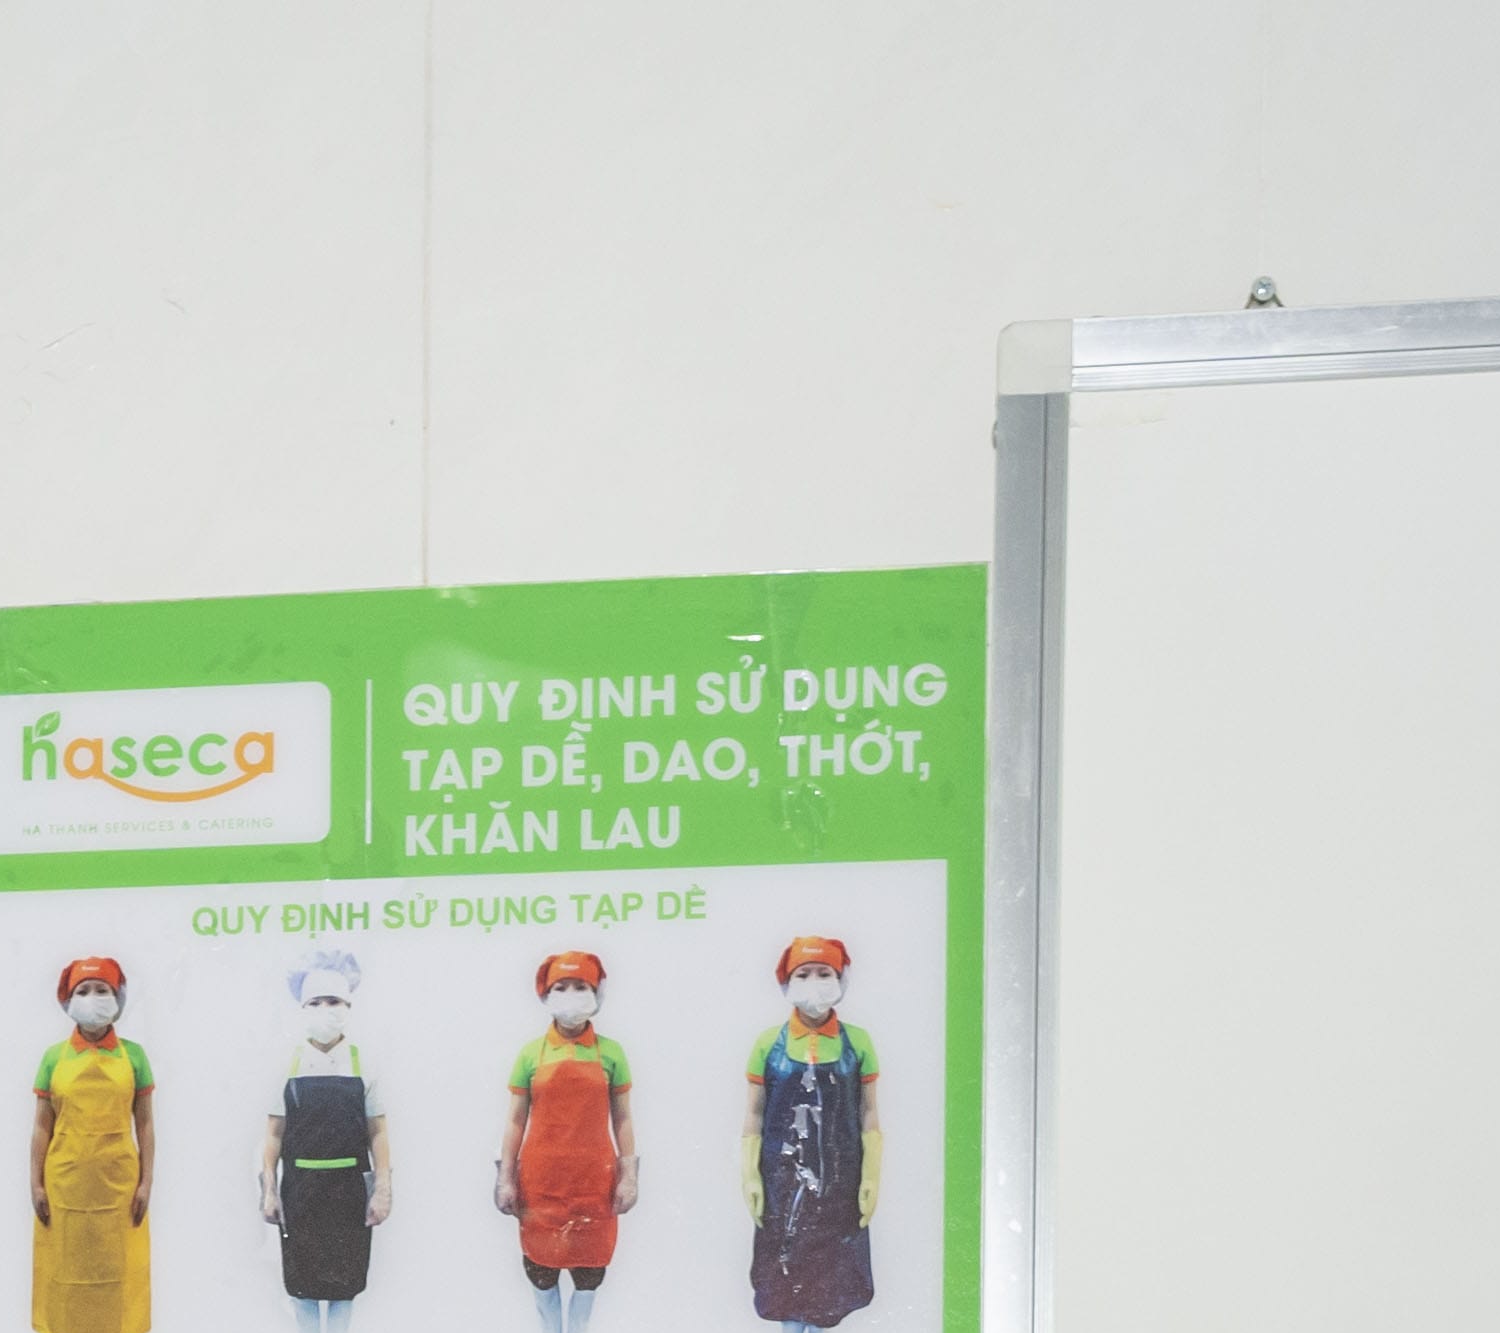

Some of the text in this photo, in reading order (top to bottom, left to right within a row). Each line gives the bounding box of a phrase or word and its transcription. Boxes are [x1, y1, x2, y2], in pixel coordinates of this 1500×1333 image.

[403, 655, 948, 733] QUY ĐỊNH SỬ DỤNG
[22, 711, 274, 792] haseca
[403, 747, 503, 803] TẠP
[623, 738, 759, 789] DAO,
[778, 719, 930, 782] THỚT,
[404, 801, 681, 857] KHĂN LAU
[192, 905, 271, 936] QUY
[281, 901, 370, 939] ĐỊNH
[382, 892, 440, 930] SỬ
[450, 894, 558, 933] DỤNG
[570, 892, 643, 930] TẠP
